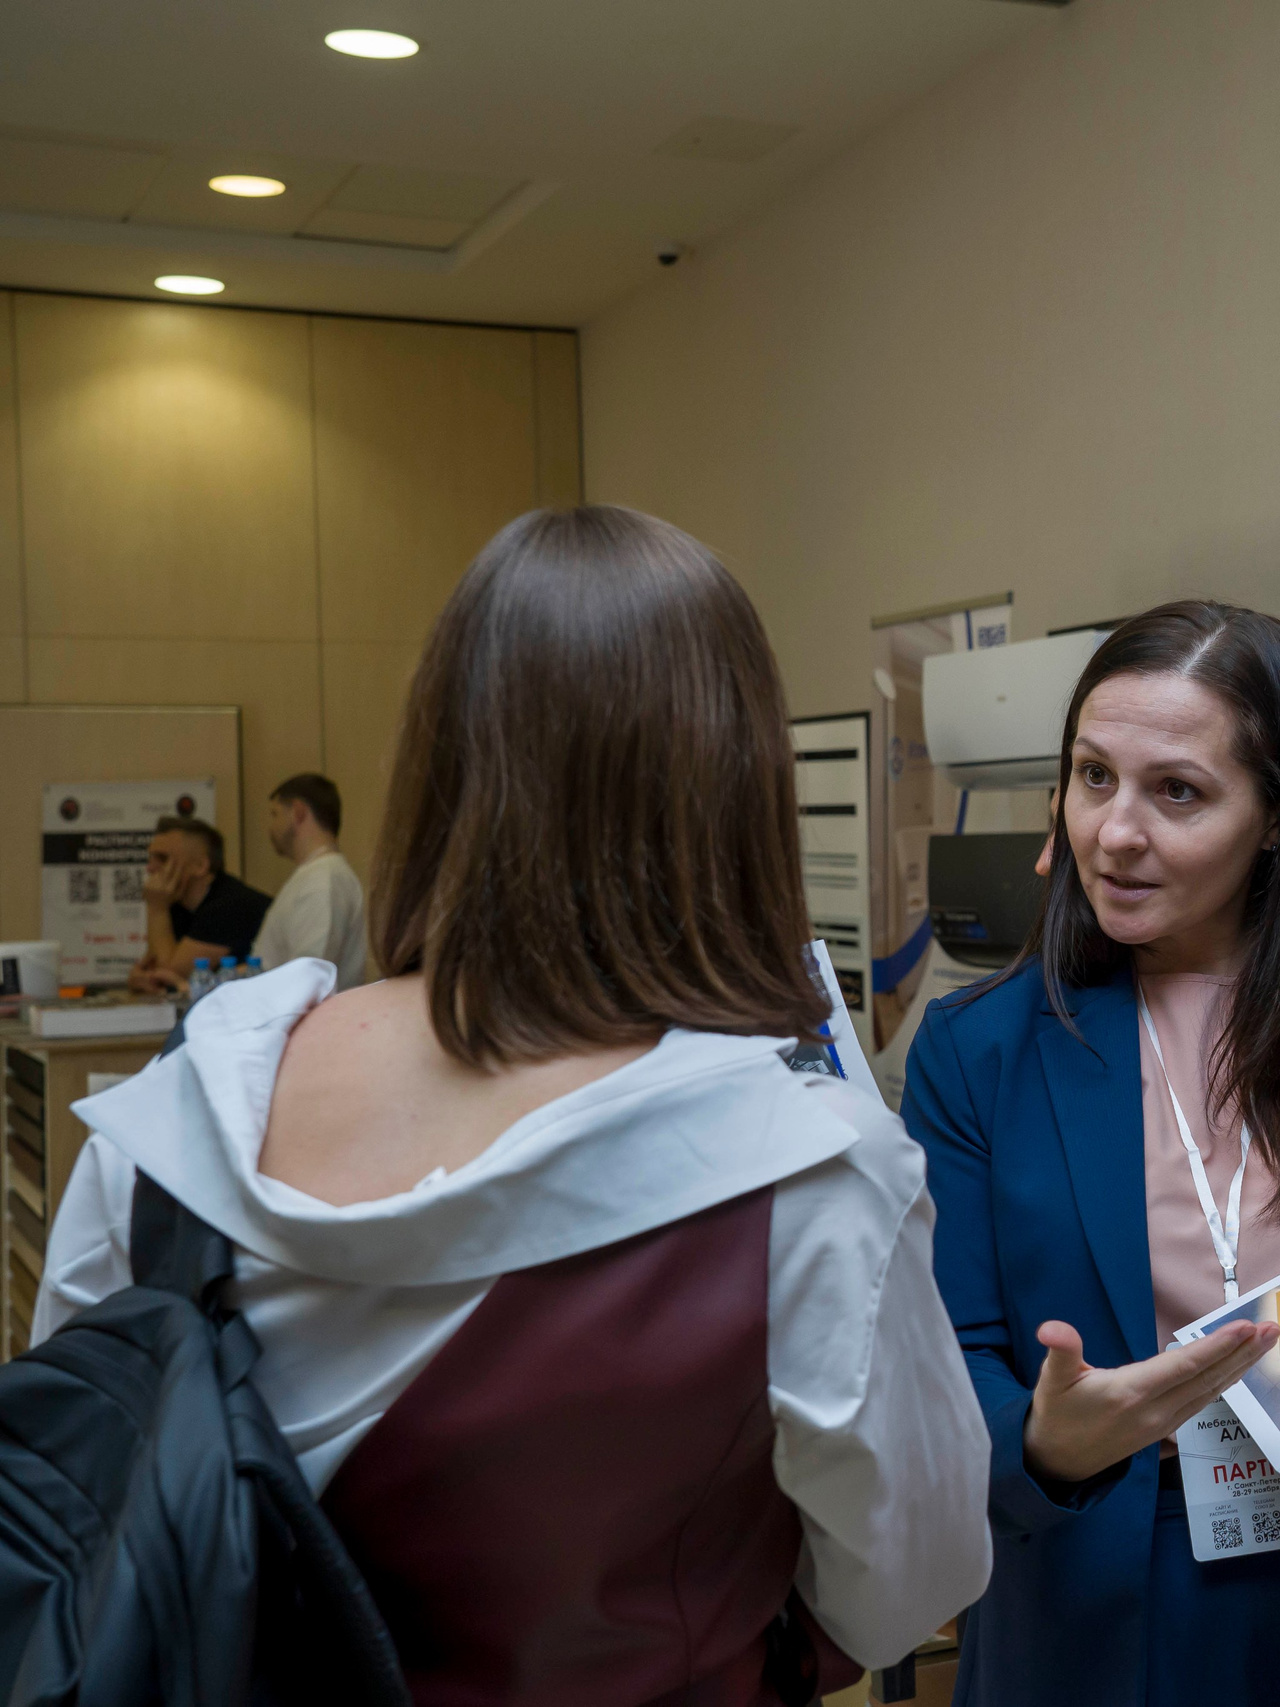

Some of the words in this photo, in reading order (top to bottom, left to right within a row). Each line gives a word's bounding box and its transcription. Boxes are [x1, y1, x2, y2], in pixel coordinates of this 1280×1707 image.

[1220, 1425, 1251, 1443] АЛ
[1232, 1488, 1252, 1498] 28-29
[1254, 1484, 1280, 1495] ноября
